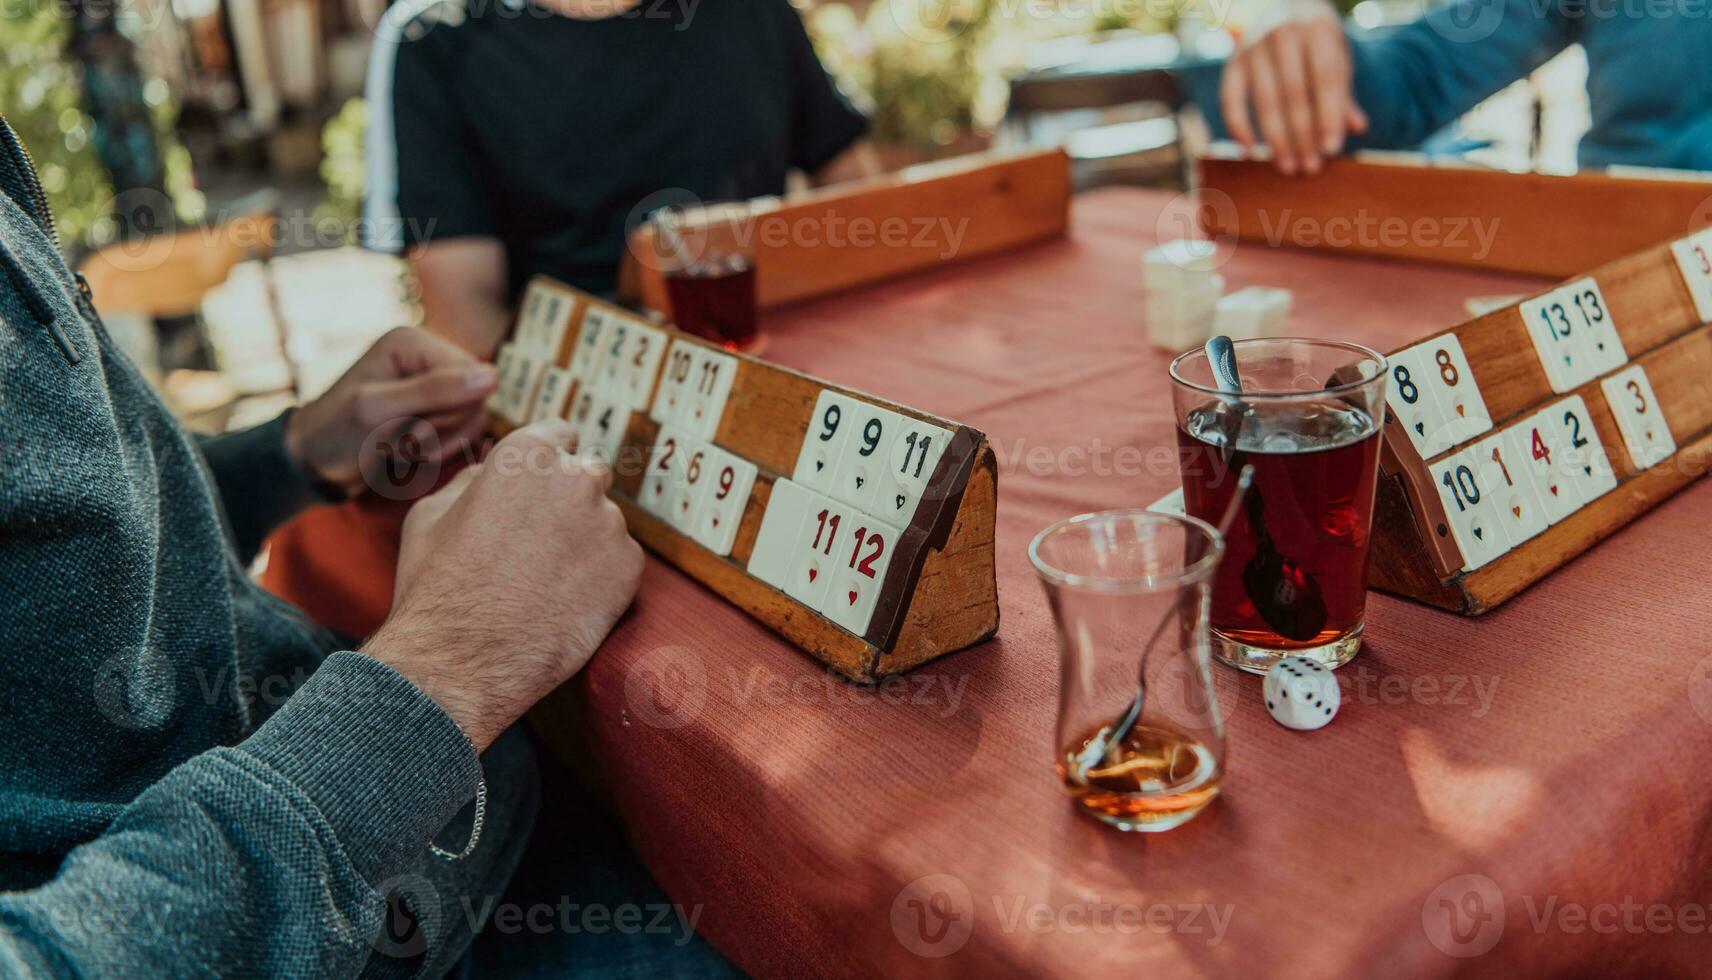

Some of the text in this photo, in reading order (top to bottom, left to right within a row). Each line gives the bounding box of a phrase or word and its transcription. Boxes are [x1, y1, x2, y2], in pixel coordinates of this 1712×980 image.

[1541, 302, 1572, 342] 13
[1574, 289, 1604, 327] 13
[632, 336, 649, 367] 2
[669, 349, 691, 384] 10
[1435, 348, 1460, 387] 8
[697, 359, 721, 397] 11
[1393, 364, 1419, 405] 8
[1626, 379, 1647, 414] 3
[818, 403, 842, 442] 9
[858, 417, 884, 457] 9
[1563, 410, 1589, 449] 2
[658, 437, 676, 471] 2
[900, 430, 933, 479] 11
[1531, 426, 1552, 465] 4
[687, 451, 705, 485] 6
[715, 465, 735, 500] 9
[1491, 447, 1513, 487] 1
[1442, 464, 1481, 513] 10
[811, 508, 842, 556] 11
[848, 526, 886, 579] 12
